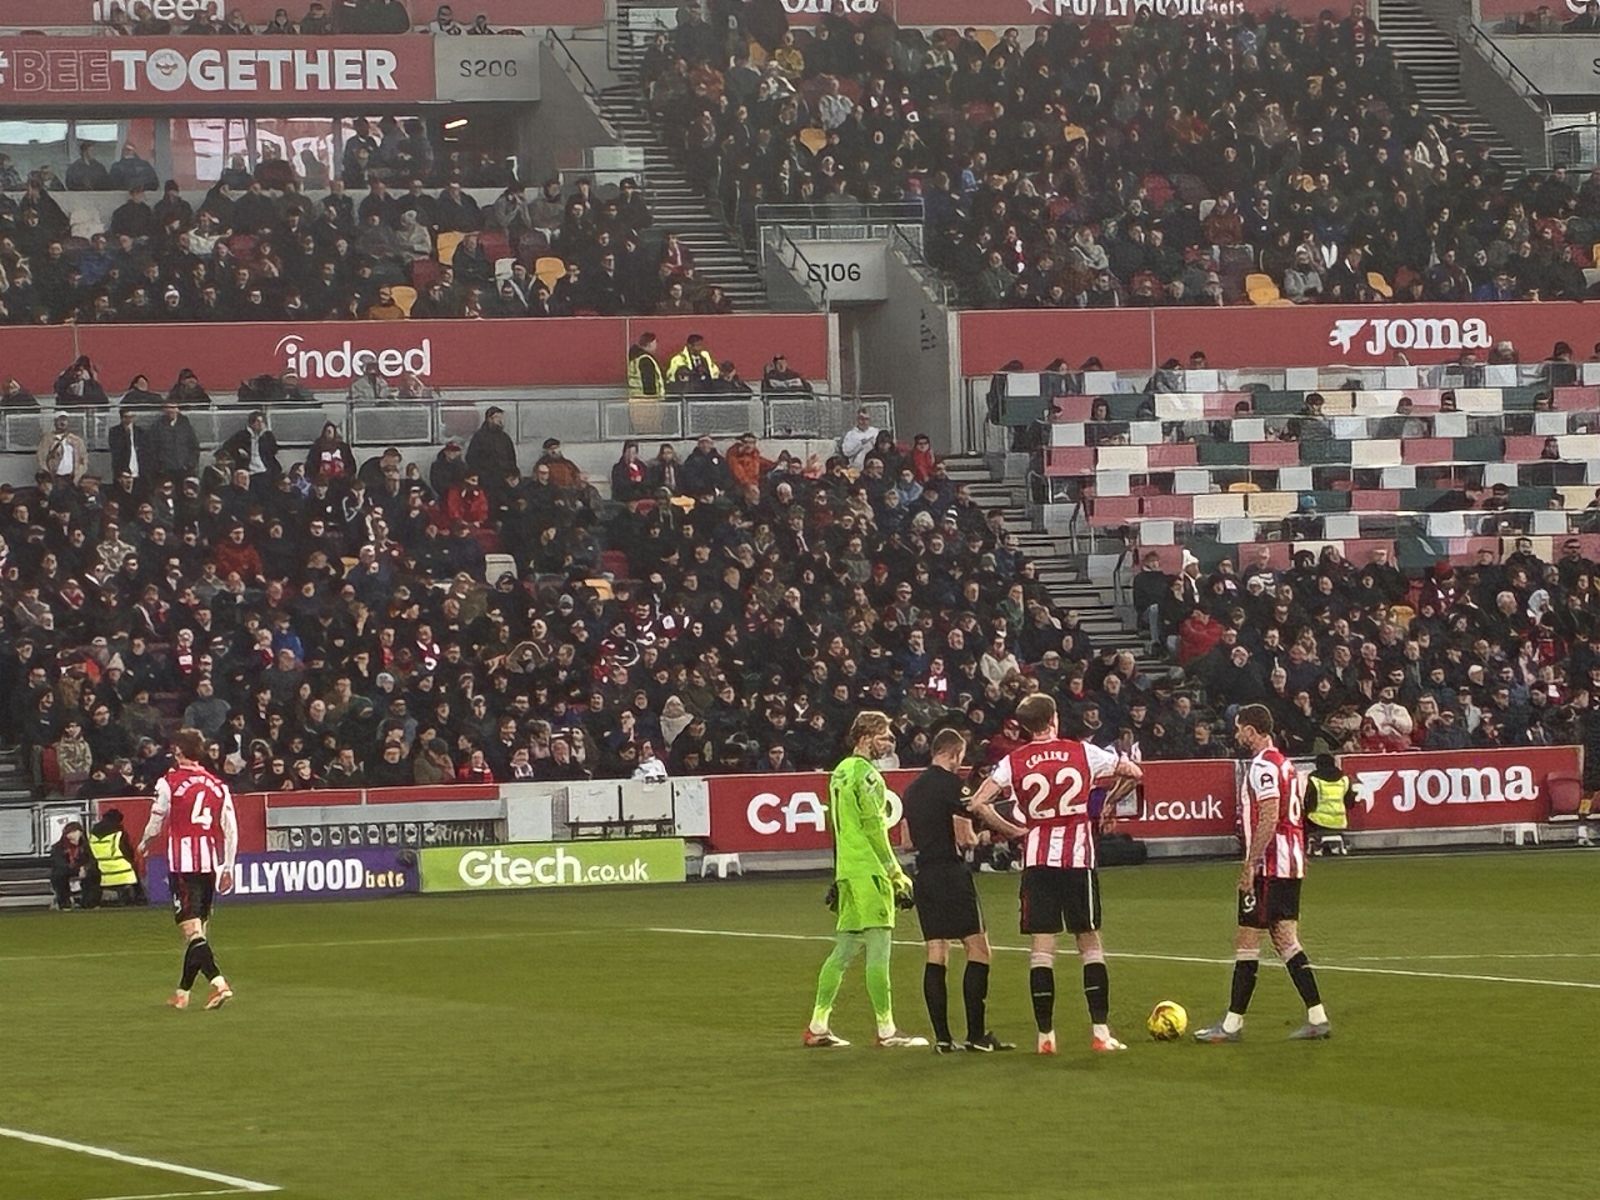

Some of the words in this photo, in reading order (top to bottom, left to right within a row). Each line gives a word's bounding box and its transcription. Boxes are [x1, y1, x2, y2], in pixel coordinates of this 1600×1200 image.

[0, 49, 398, 91] BEETOGETHER
[459, 59, 518, 78] S206
[807, 263, 861, 282] S106
[274, 334, 431, 378] indeed
[191, 790, 213, 831] 4
[1021, 767, 1088, 820] 22
[458, 847, 649, 887] Gtech.co.uk
